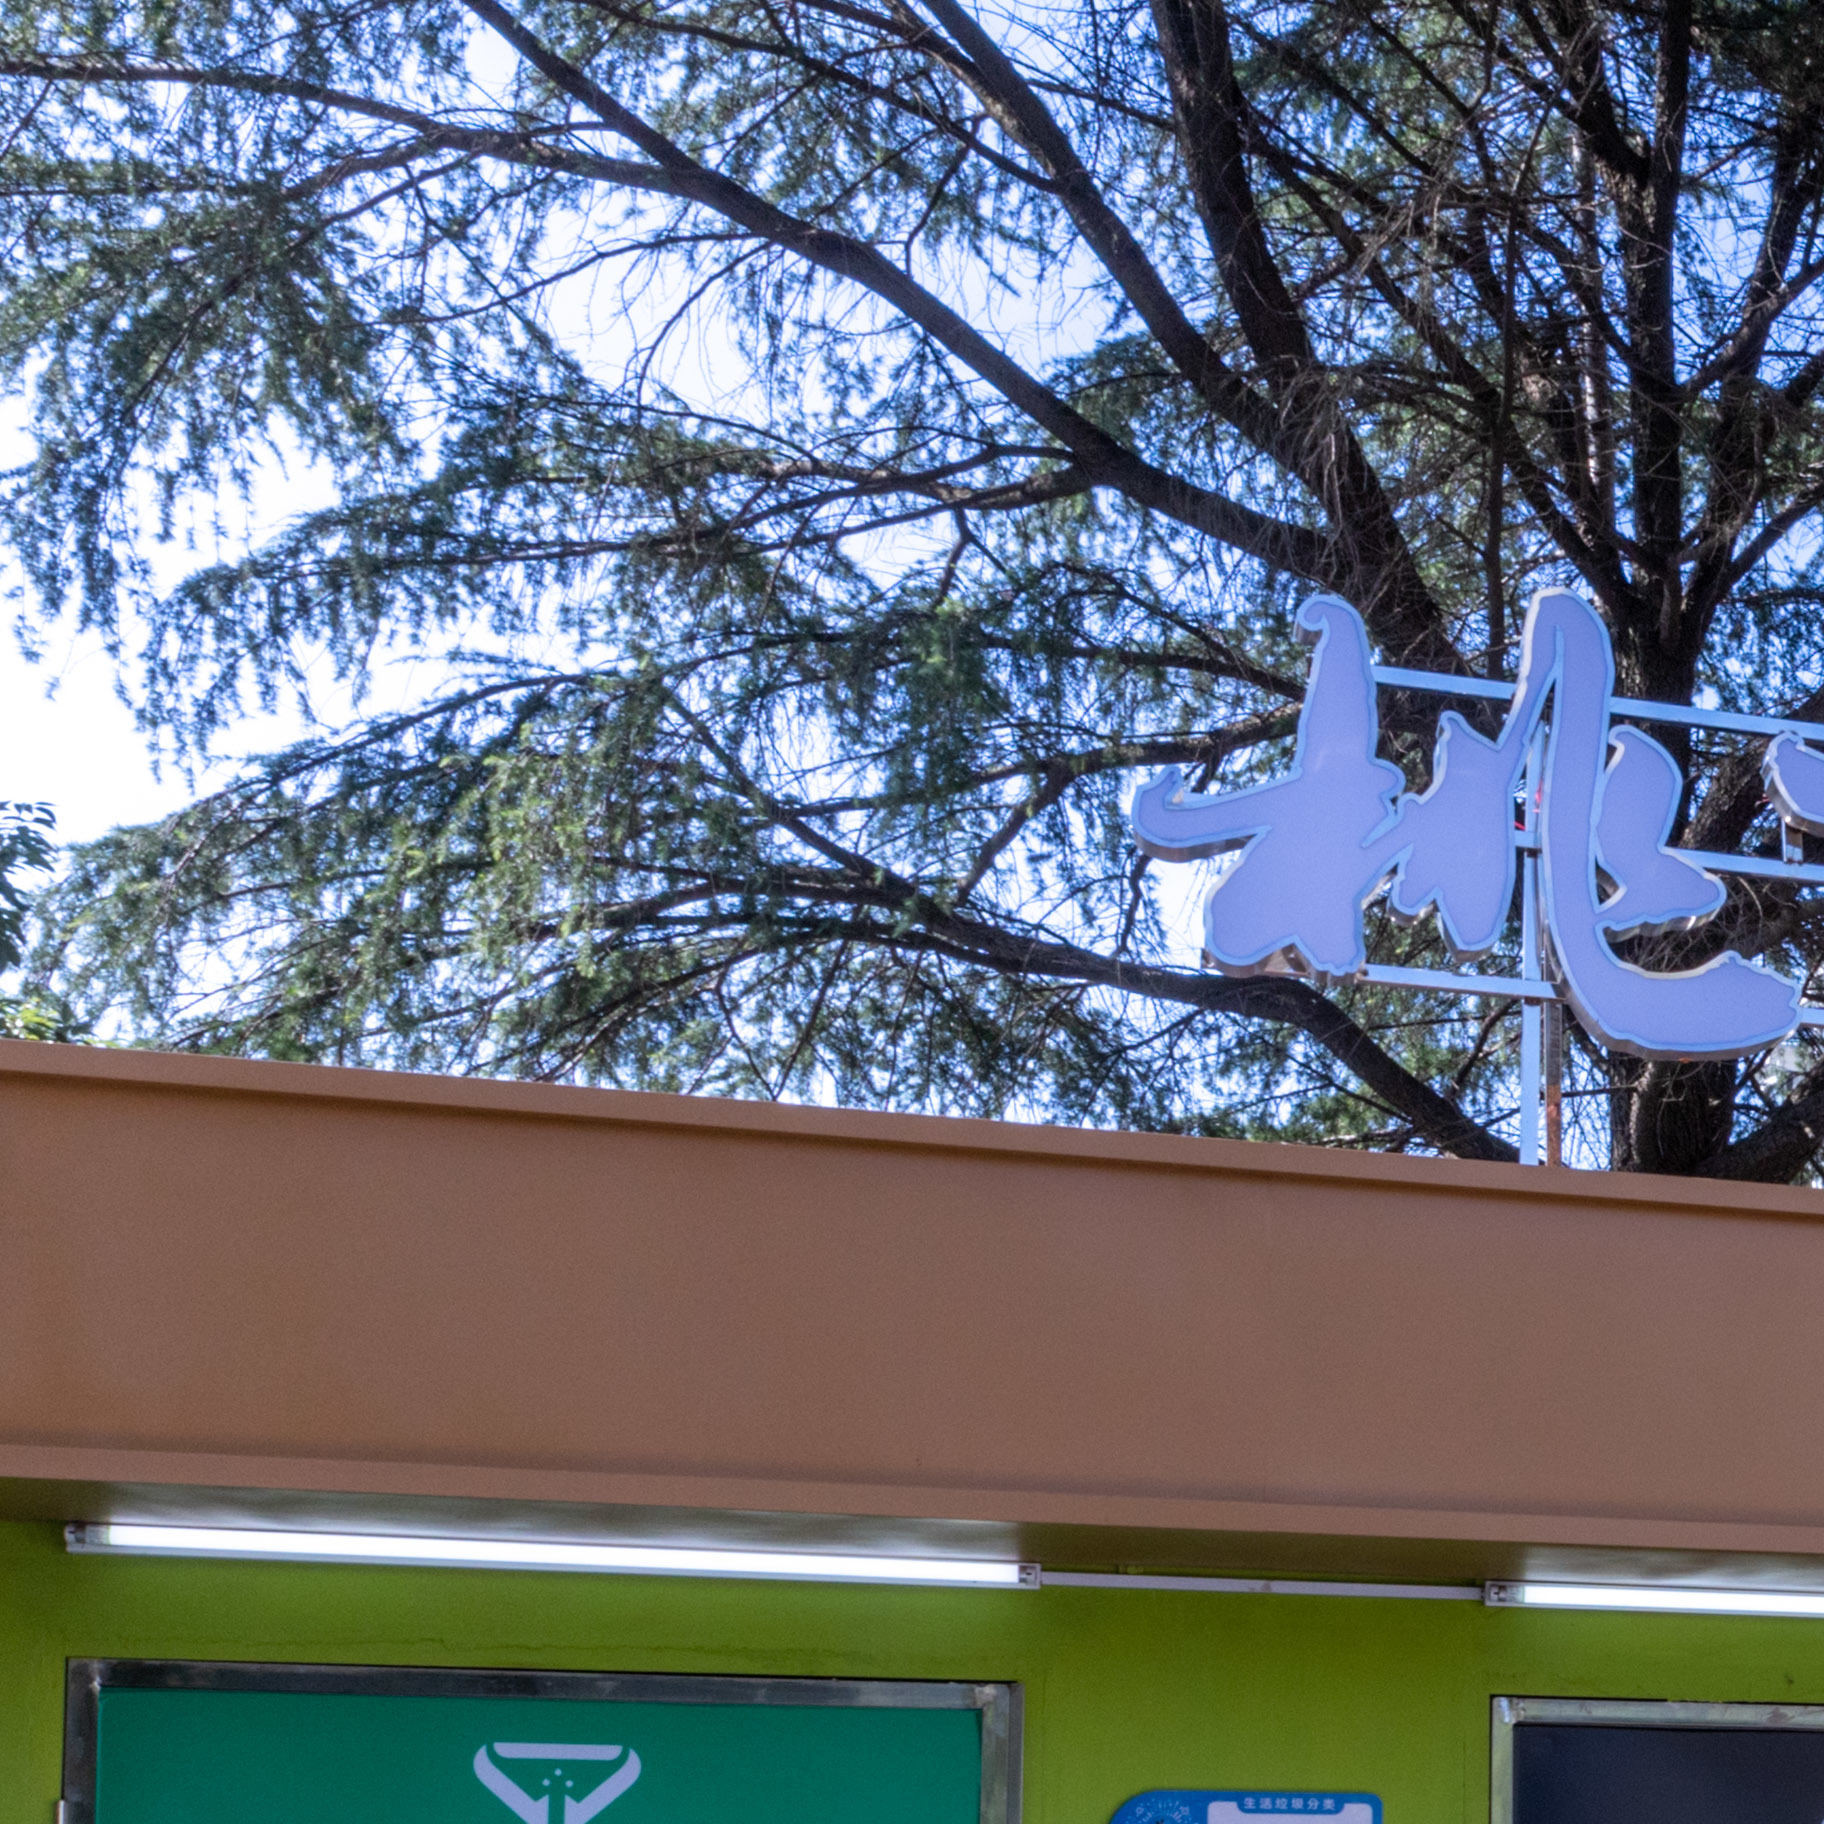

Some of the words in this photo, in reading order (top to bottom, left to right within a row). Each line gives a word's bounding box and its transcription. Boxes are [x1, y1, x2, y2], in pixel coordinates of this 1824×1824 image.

[1244, 1797, 1335, 1811] 生活垃圾分类
